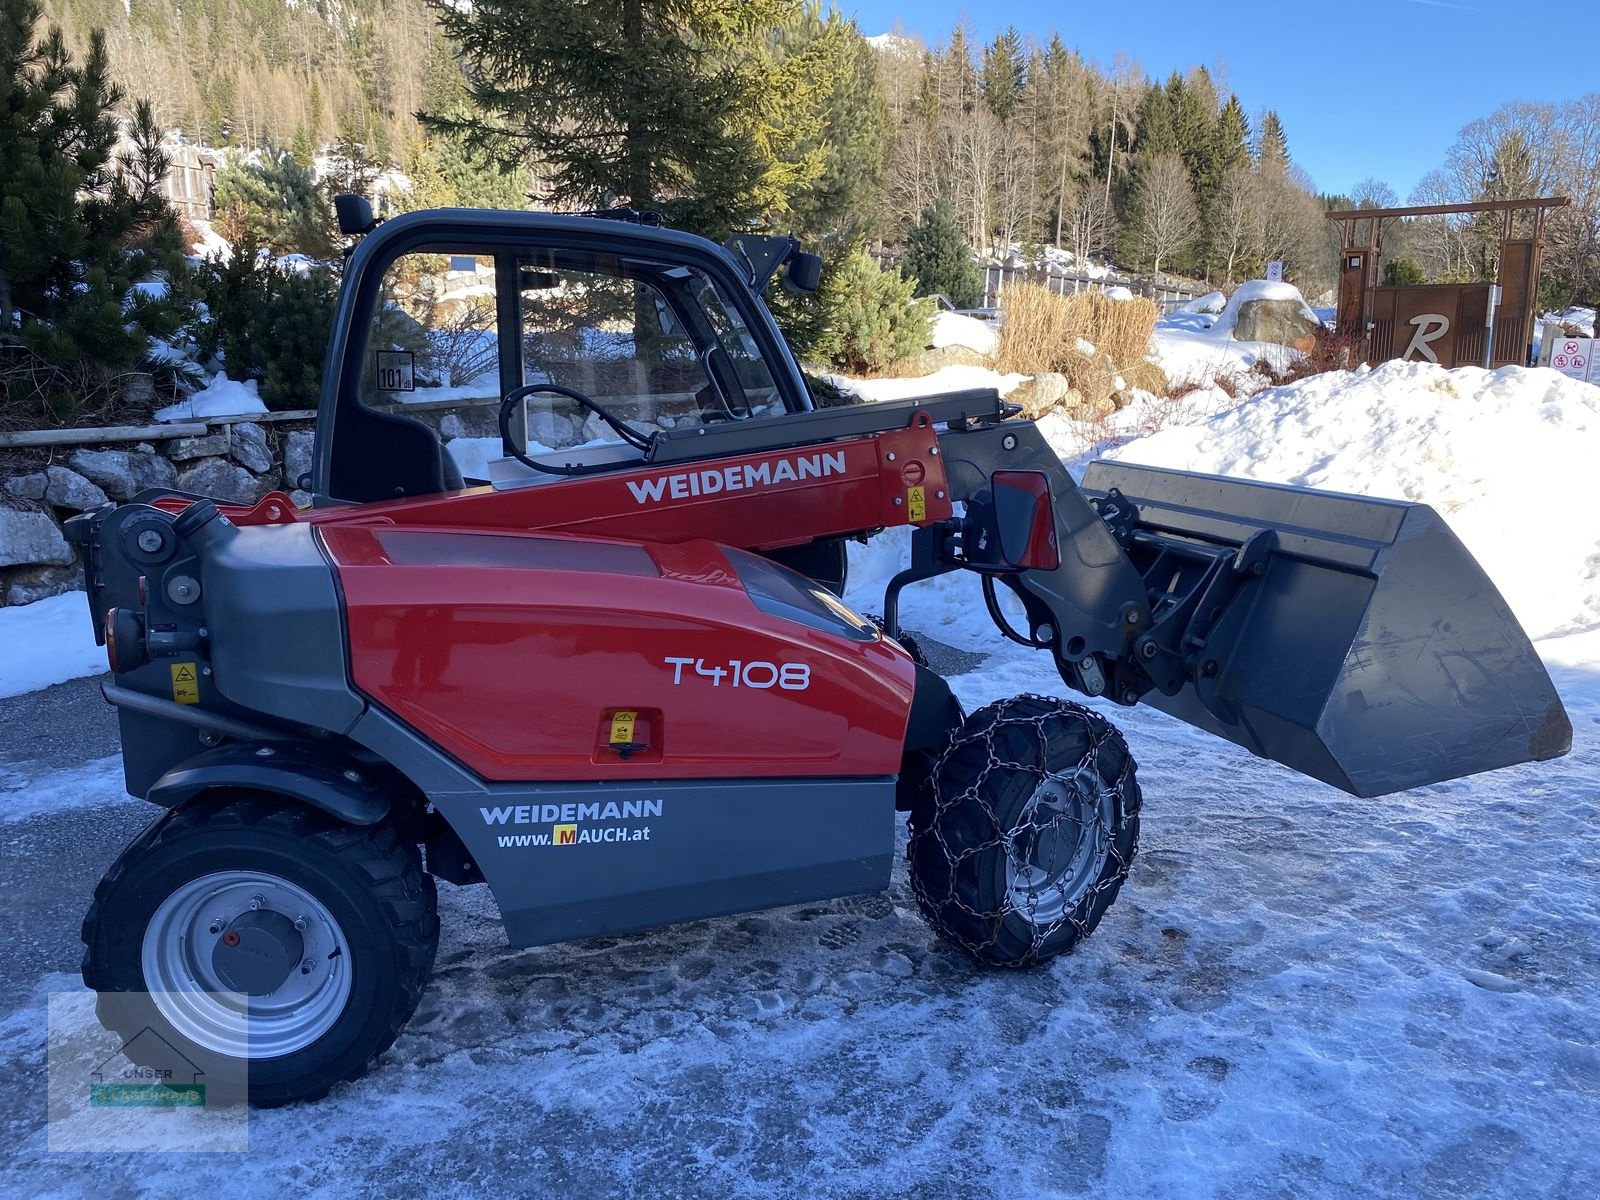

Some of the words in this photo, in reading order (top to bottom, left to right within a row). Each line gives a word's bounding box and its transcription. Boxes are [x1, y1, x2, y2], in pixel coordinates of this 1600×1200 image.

[1401, 313, 1450, 363] R
[380, 368, 401, 388] 101
[626, 451, 846, 504] WEIDEMANN
[664, 656, 811, 690] T4108
[479, 799, 663, 825] WEIDEMANN
[498, 826, 650, 847] www.MAUCH.at
